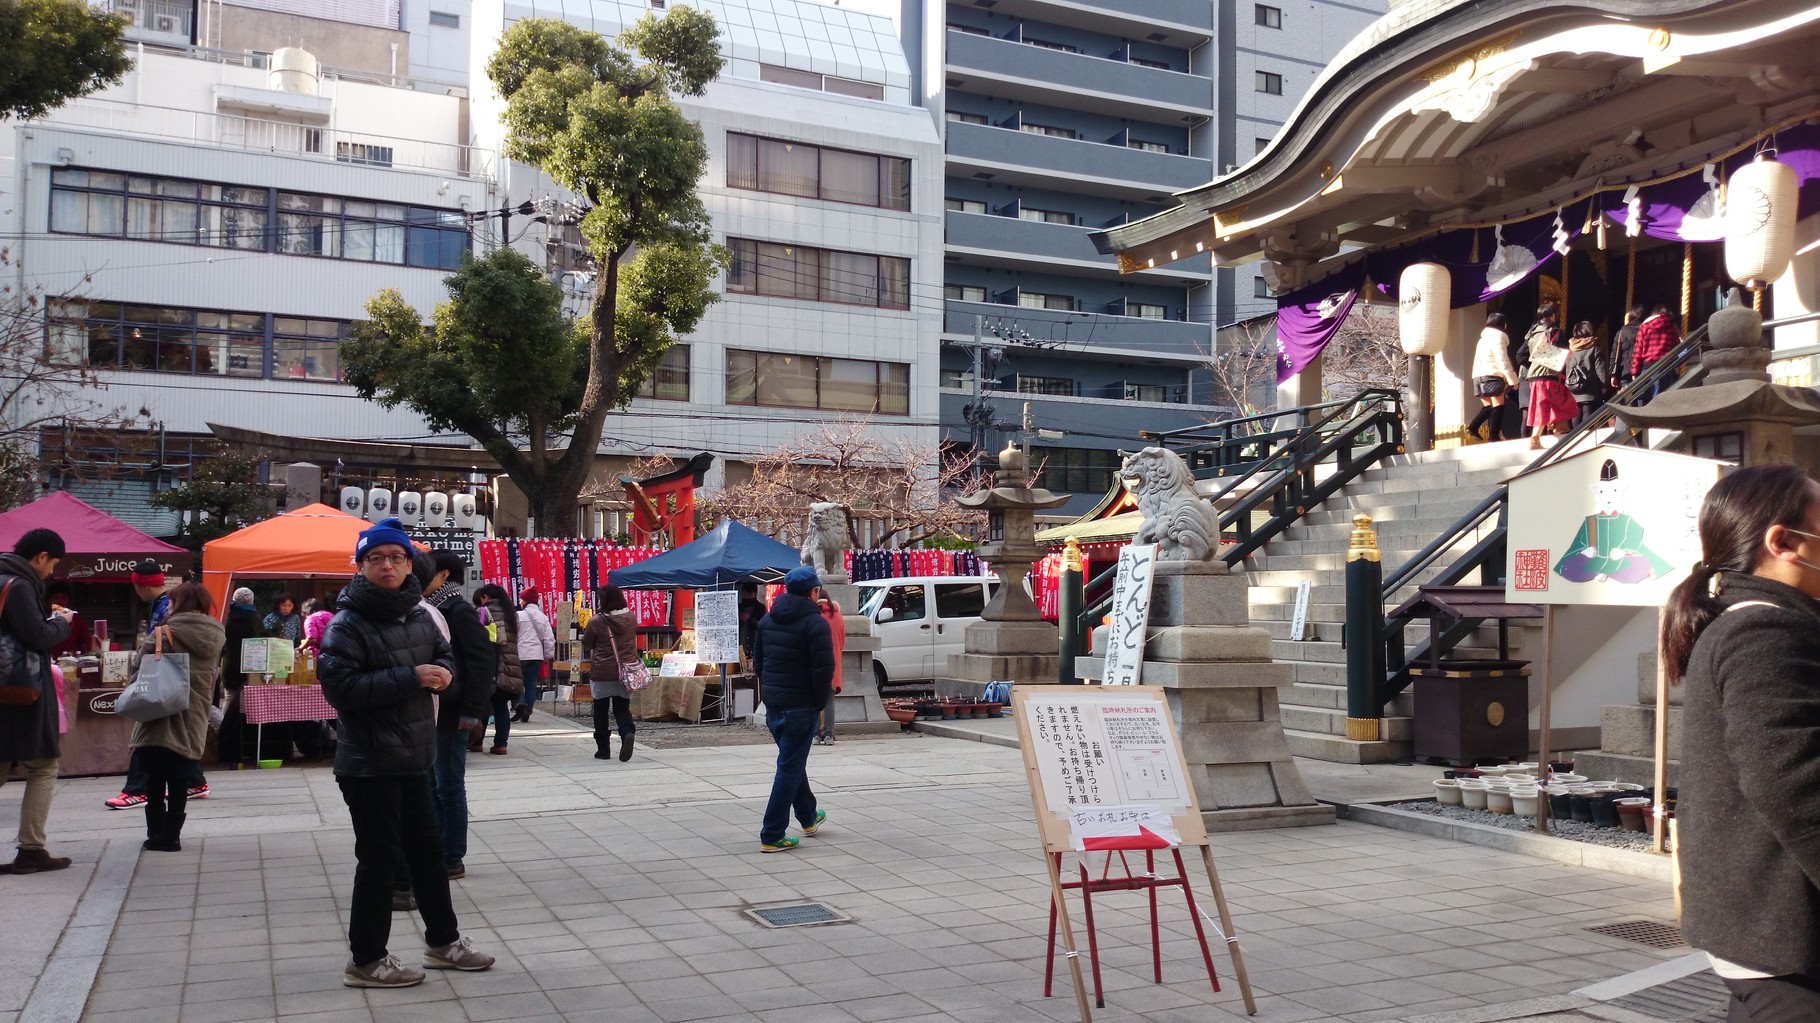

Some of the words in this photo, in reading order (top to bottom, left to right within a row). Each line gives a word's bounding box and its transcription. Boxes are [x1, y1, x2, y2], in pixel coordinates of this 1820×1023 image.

[95, 558, 137, 572] Juice
[424, 539, 475, 550] arime
[1107, 552, 1130, 684] 午前中までにお持ち
[1125, 553, 1149, 649] とんど
[93, 699, 118, 710] Nex
[1036, 706, 1050, 742] ください。
[1047, 706, 1076, 804] きますので、予めご了承
[1059, 706, 1089, 804] れません。お持ち帰り頂
[1071, 706, 1100, 804] 燃えない物は受けつけら
[1092, 741, 1104, 766] お願い
